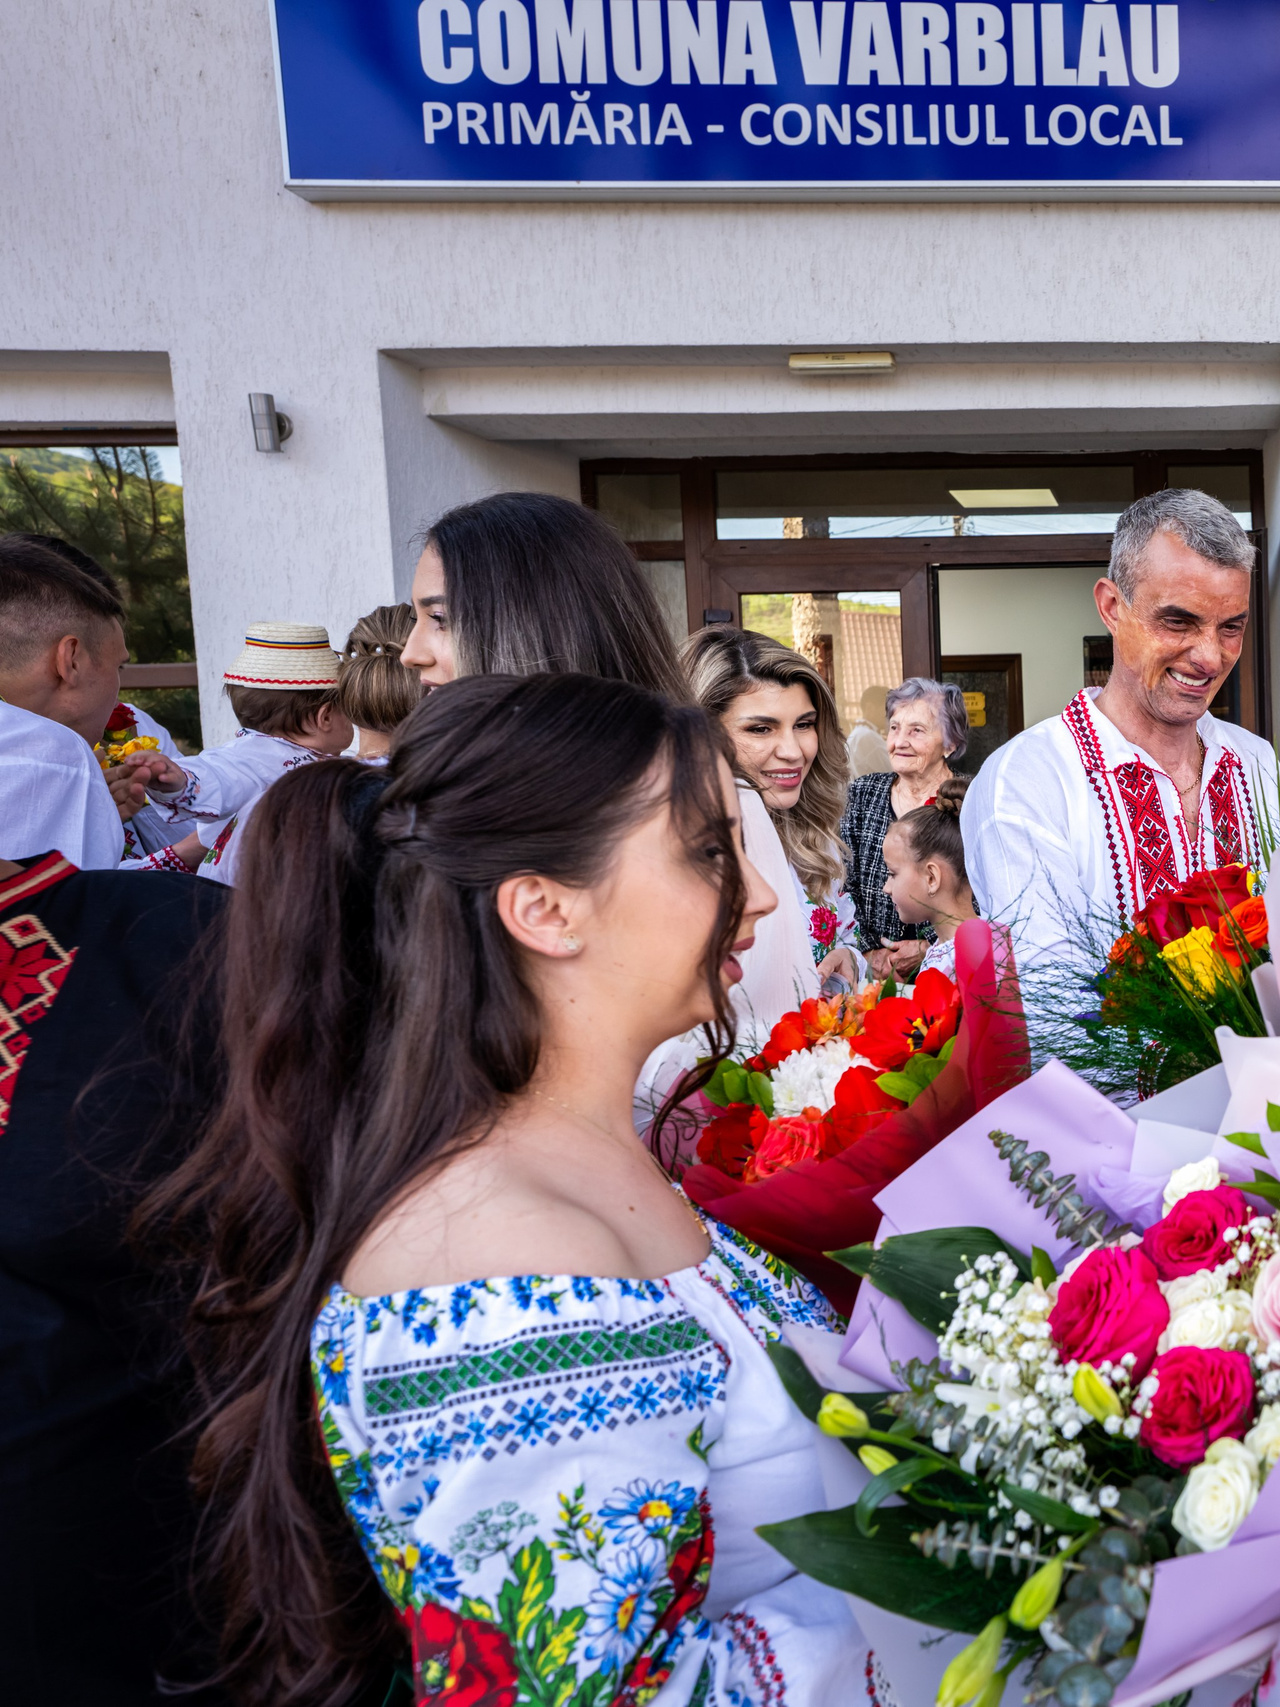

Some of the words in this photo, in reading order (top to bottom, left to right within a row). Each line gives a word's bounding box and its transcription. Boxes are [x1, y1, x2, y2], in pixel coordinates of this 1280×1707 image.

[418, 0, 777, 85] COMUNA
[422, 91, 692, 144] PRIMĂRIA
[741, 104, 1009, 145] CONSILIUL
[1025, 104, 1183, 145] LOCAL
